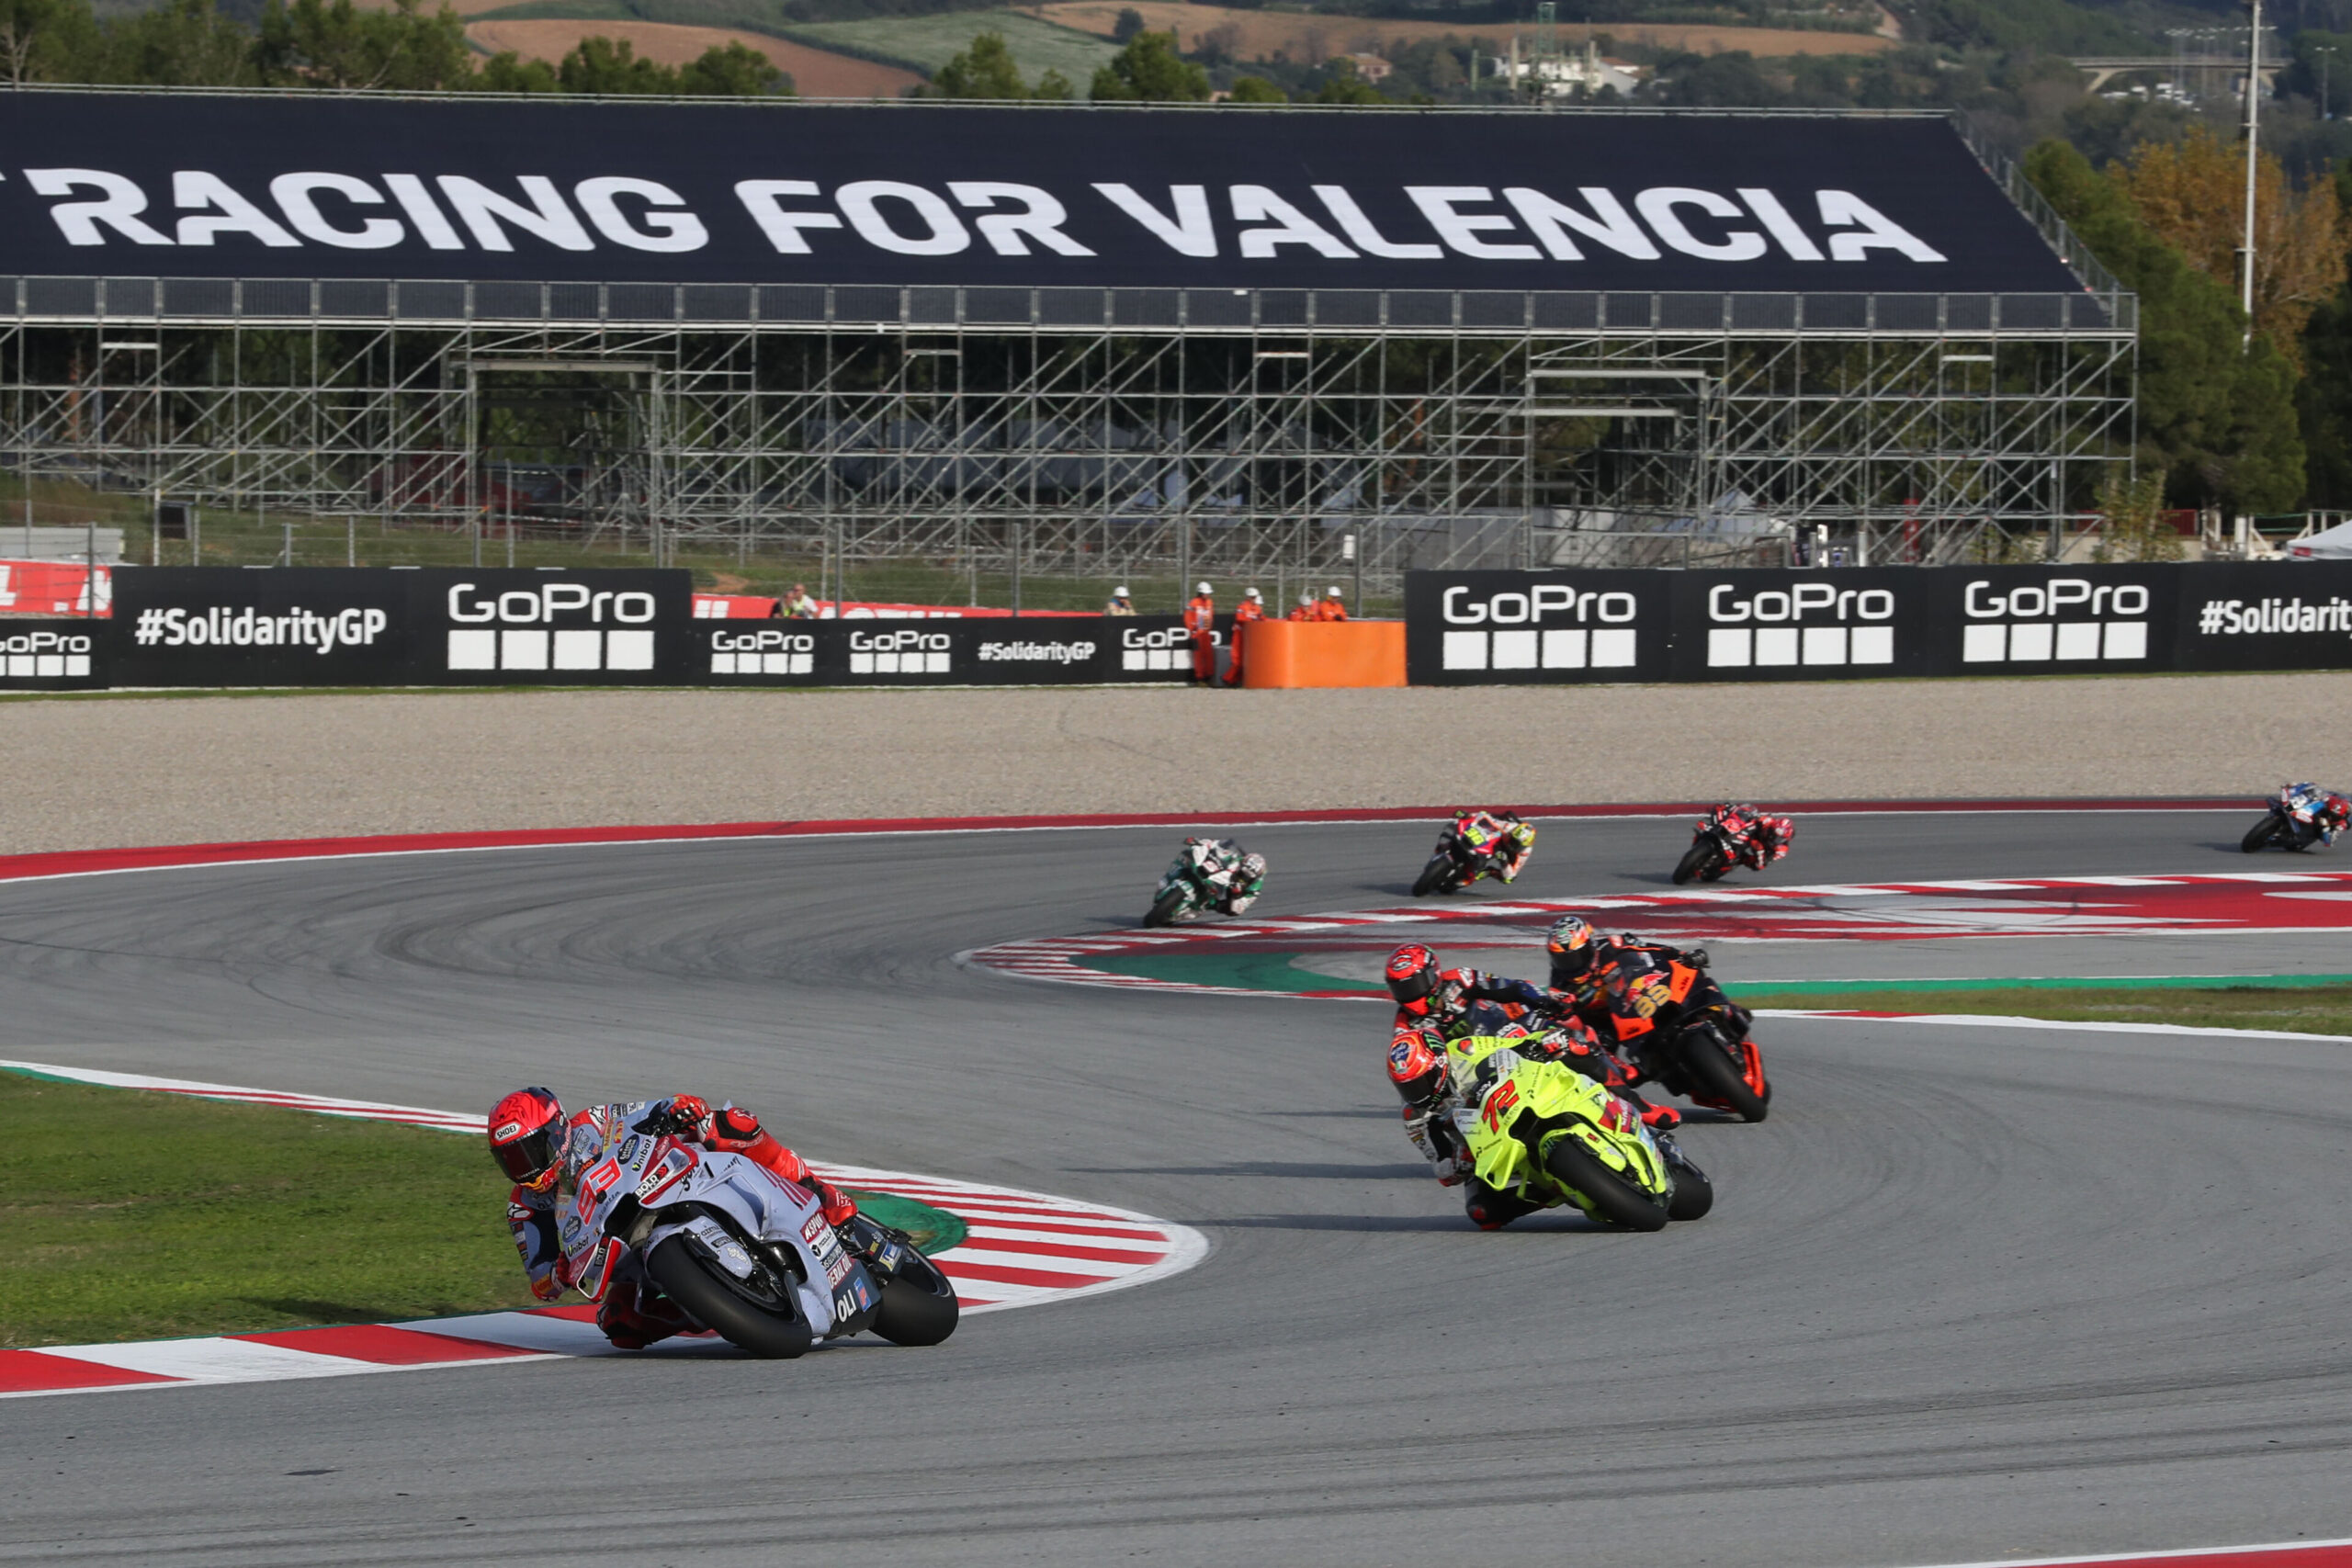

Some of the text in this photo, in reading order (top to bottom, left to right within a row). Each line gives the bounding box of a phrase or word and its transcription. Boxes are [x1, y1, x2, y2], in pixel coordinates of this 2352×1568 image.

[22, 167, 1948, 263] RACING FOR VALENCIA
[447, 582, 656, 624] GoPro
[1443, 584, 1636, 625] GoPro
[1709, 583, 1894, 622] GoPro
[1964, 579, 2149, 618] GoPro
[135, 606, 387, 655] #SolidarityGP
[2199, 596, 2352, 639] #Solidarit
[0, 631, 91, 653] oPro
[711, 630, 814, 652] GoPro
[850, 630, 951, 651] GoPro
[978, 641, 1096, 665] #SolidarityGP
[1123, 626, 1223, 649] GoPo
[1635, 984, 1672, 1020] 33
[1482, 1078, 1521, 1135] 72
[496, 1123, 517, 1140] SHOEI
[632, 1138, 653, 1172] Unibat
[576, 1155, 624, 1227] 93
[634, 1174, 660, 1198] BOLD
[567, 1235, 590, 1258] Unibat
